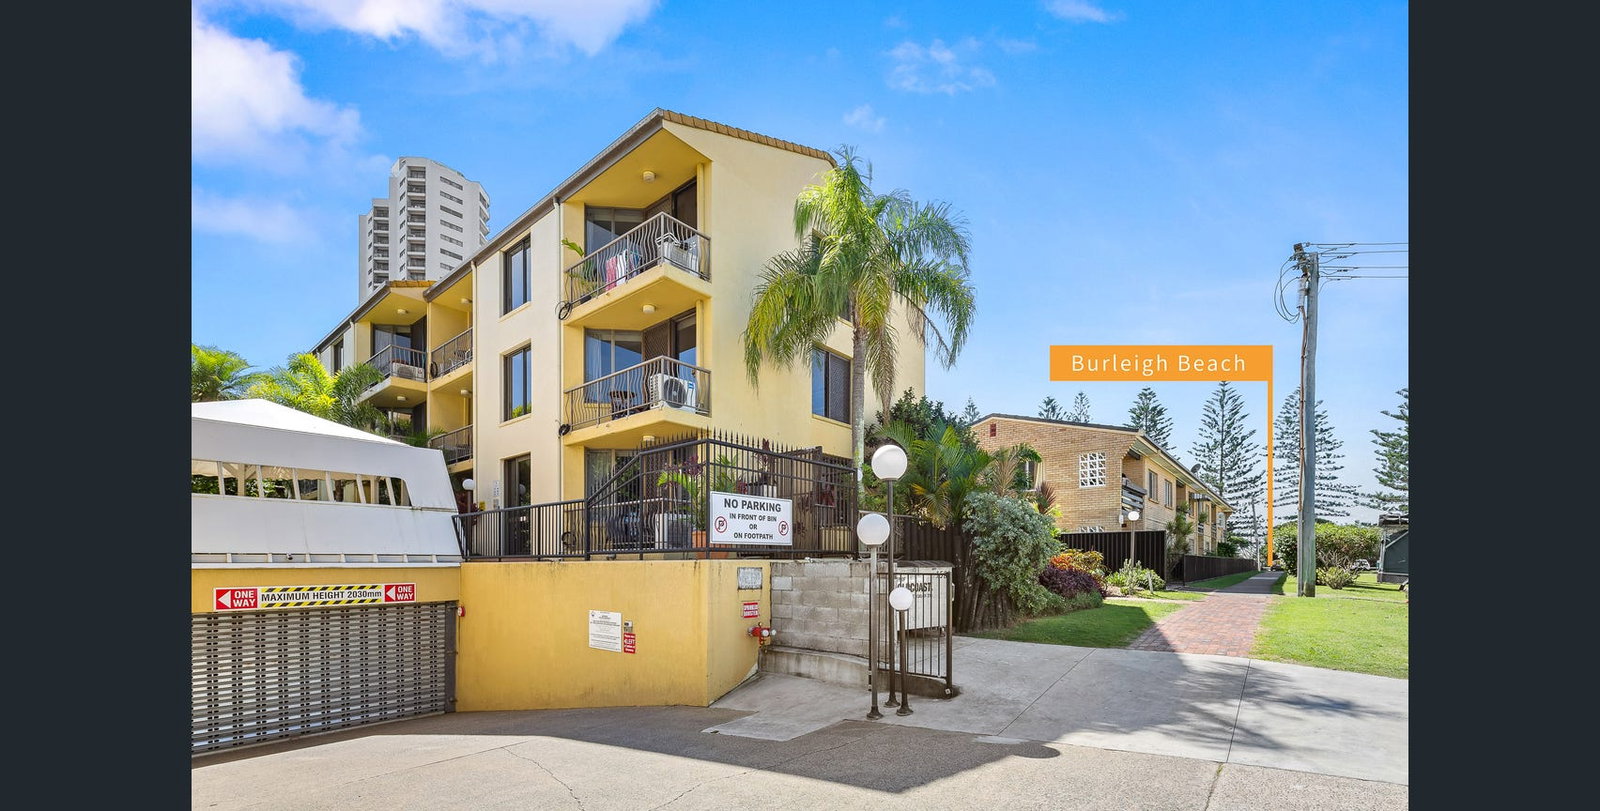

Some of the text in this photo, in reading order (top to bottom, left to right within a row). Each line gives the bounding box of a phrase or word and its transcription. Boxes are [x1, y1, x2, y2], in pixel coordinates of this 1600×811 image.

[724, 498, 782, 512] NO PARKING
[729, 512, 736, 520] IN
[737, 513, 757, 521] FRONT
[758, 514, 766, 522] OF
[744, 532, 774, 540] FOOTPATH
[397, 585, 413, 593] ONE
[234, 590, 255, 599] ONE
[261, 590, 382, 602] MAXIMUM HEIGHT 2030mm
[396, 592, 414, 601] WAY
[232, 599, 256, 608] WAY
